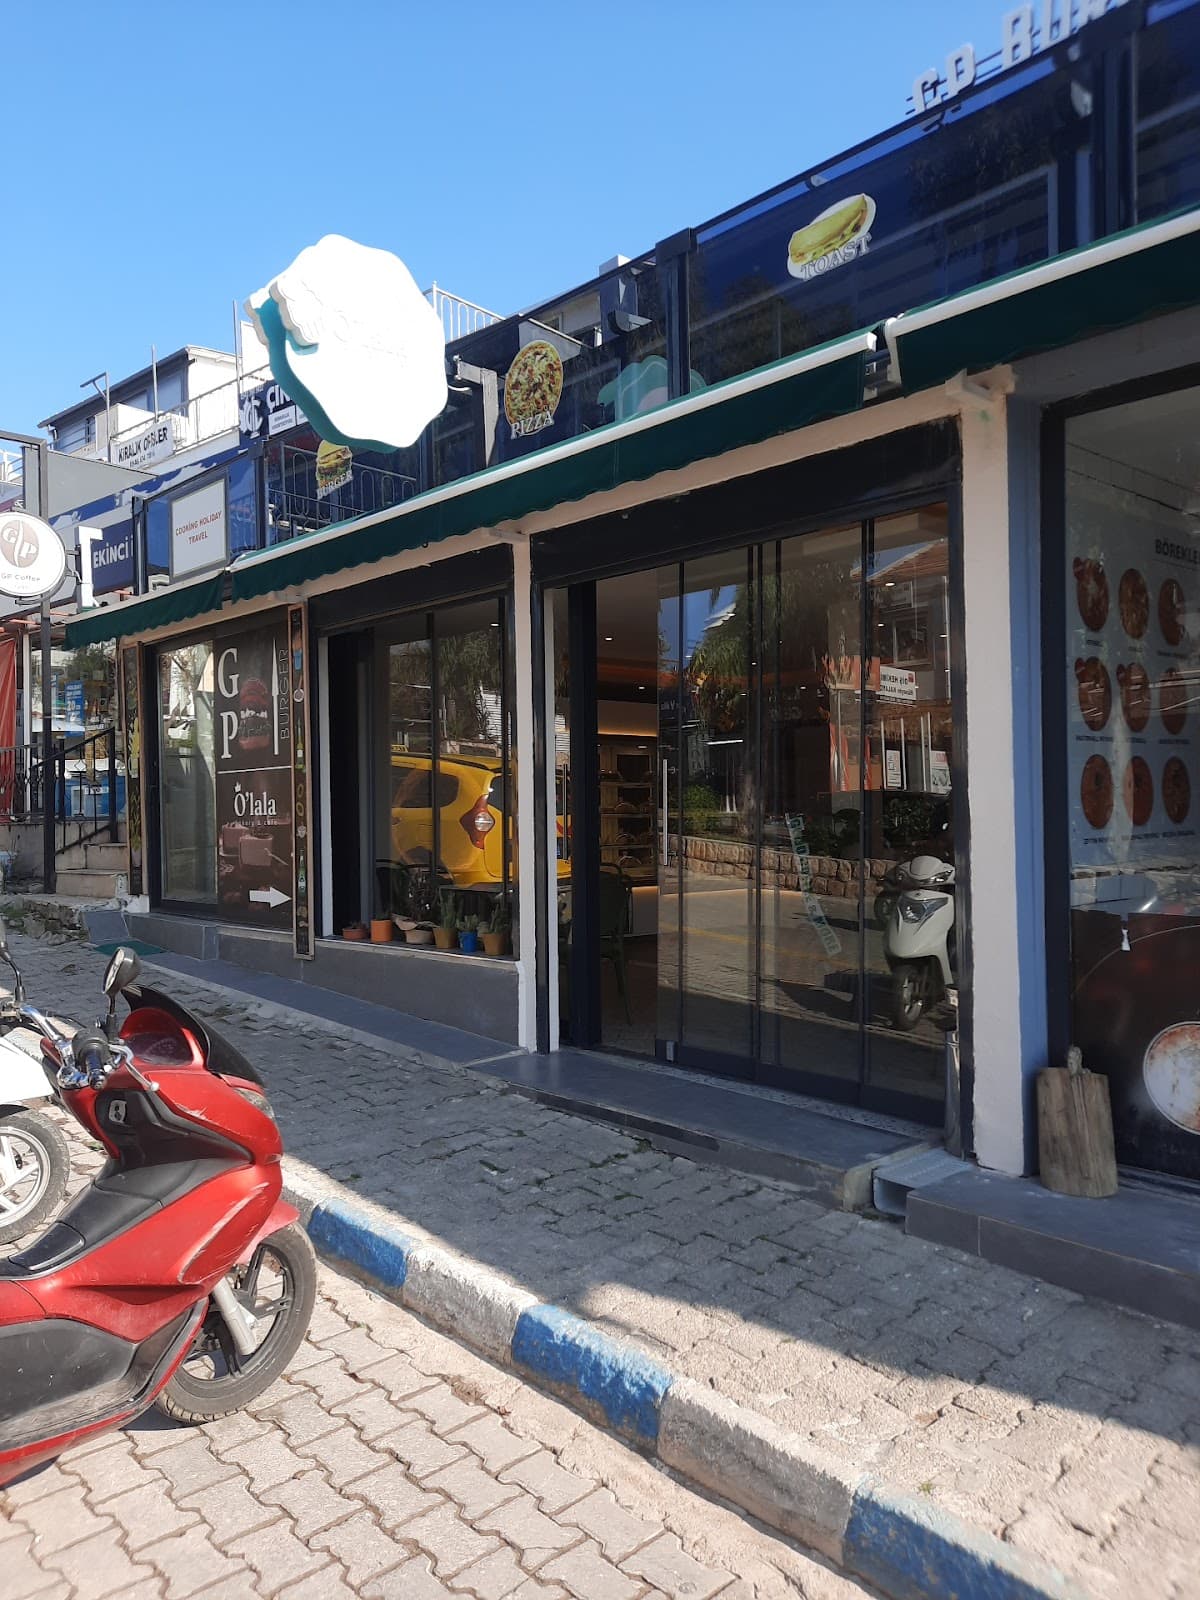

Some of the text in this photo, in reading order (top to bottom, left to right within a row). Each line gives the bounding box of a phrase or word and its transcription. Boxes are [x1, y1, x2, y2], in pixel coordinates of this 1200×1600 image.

[800, 232, 872, 281] TOAST
[510, 410, 555, 440] PIZZA
[316, 469, 353, 500] BURGER
[93, 535, 129, 569] EKİNCİ
[188, 530, 208, 545] TRAVEL
[1154, 538, 1200, 566] BÖREKLE
[217, 647, 240, 699] G
[279, 648, 290, 740] BURGER
[219, 711, 239, 759] P
